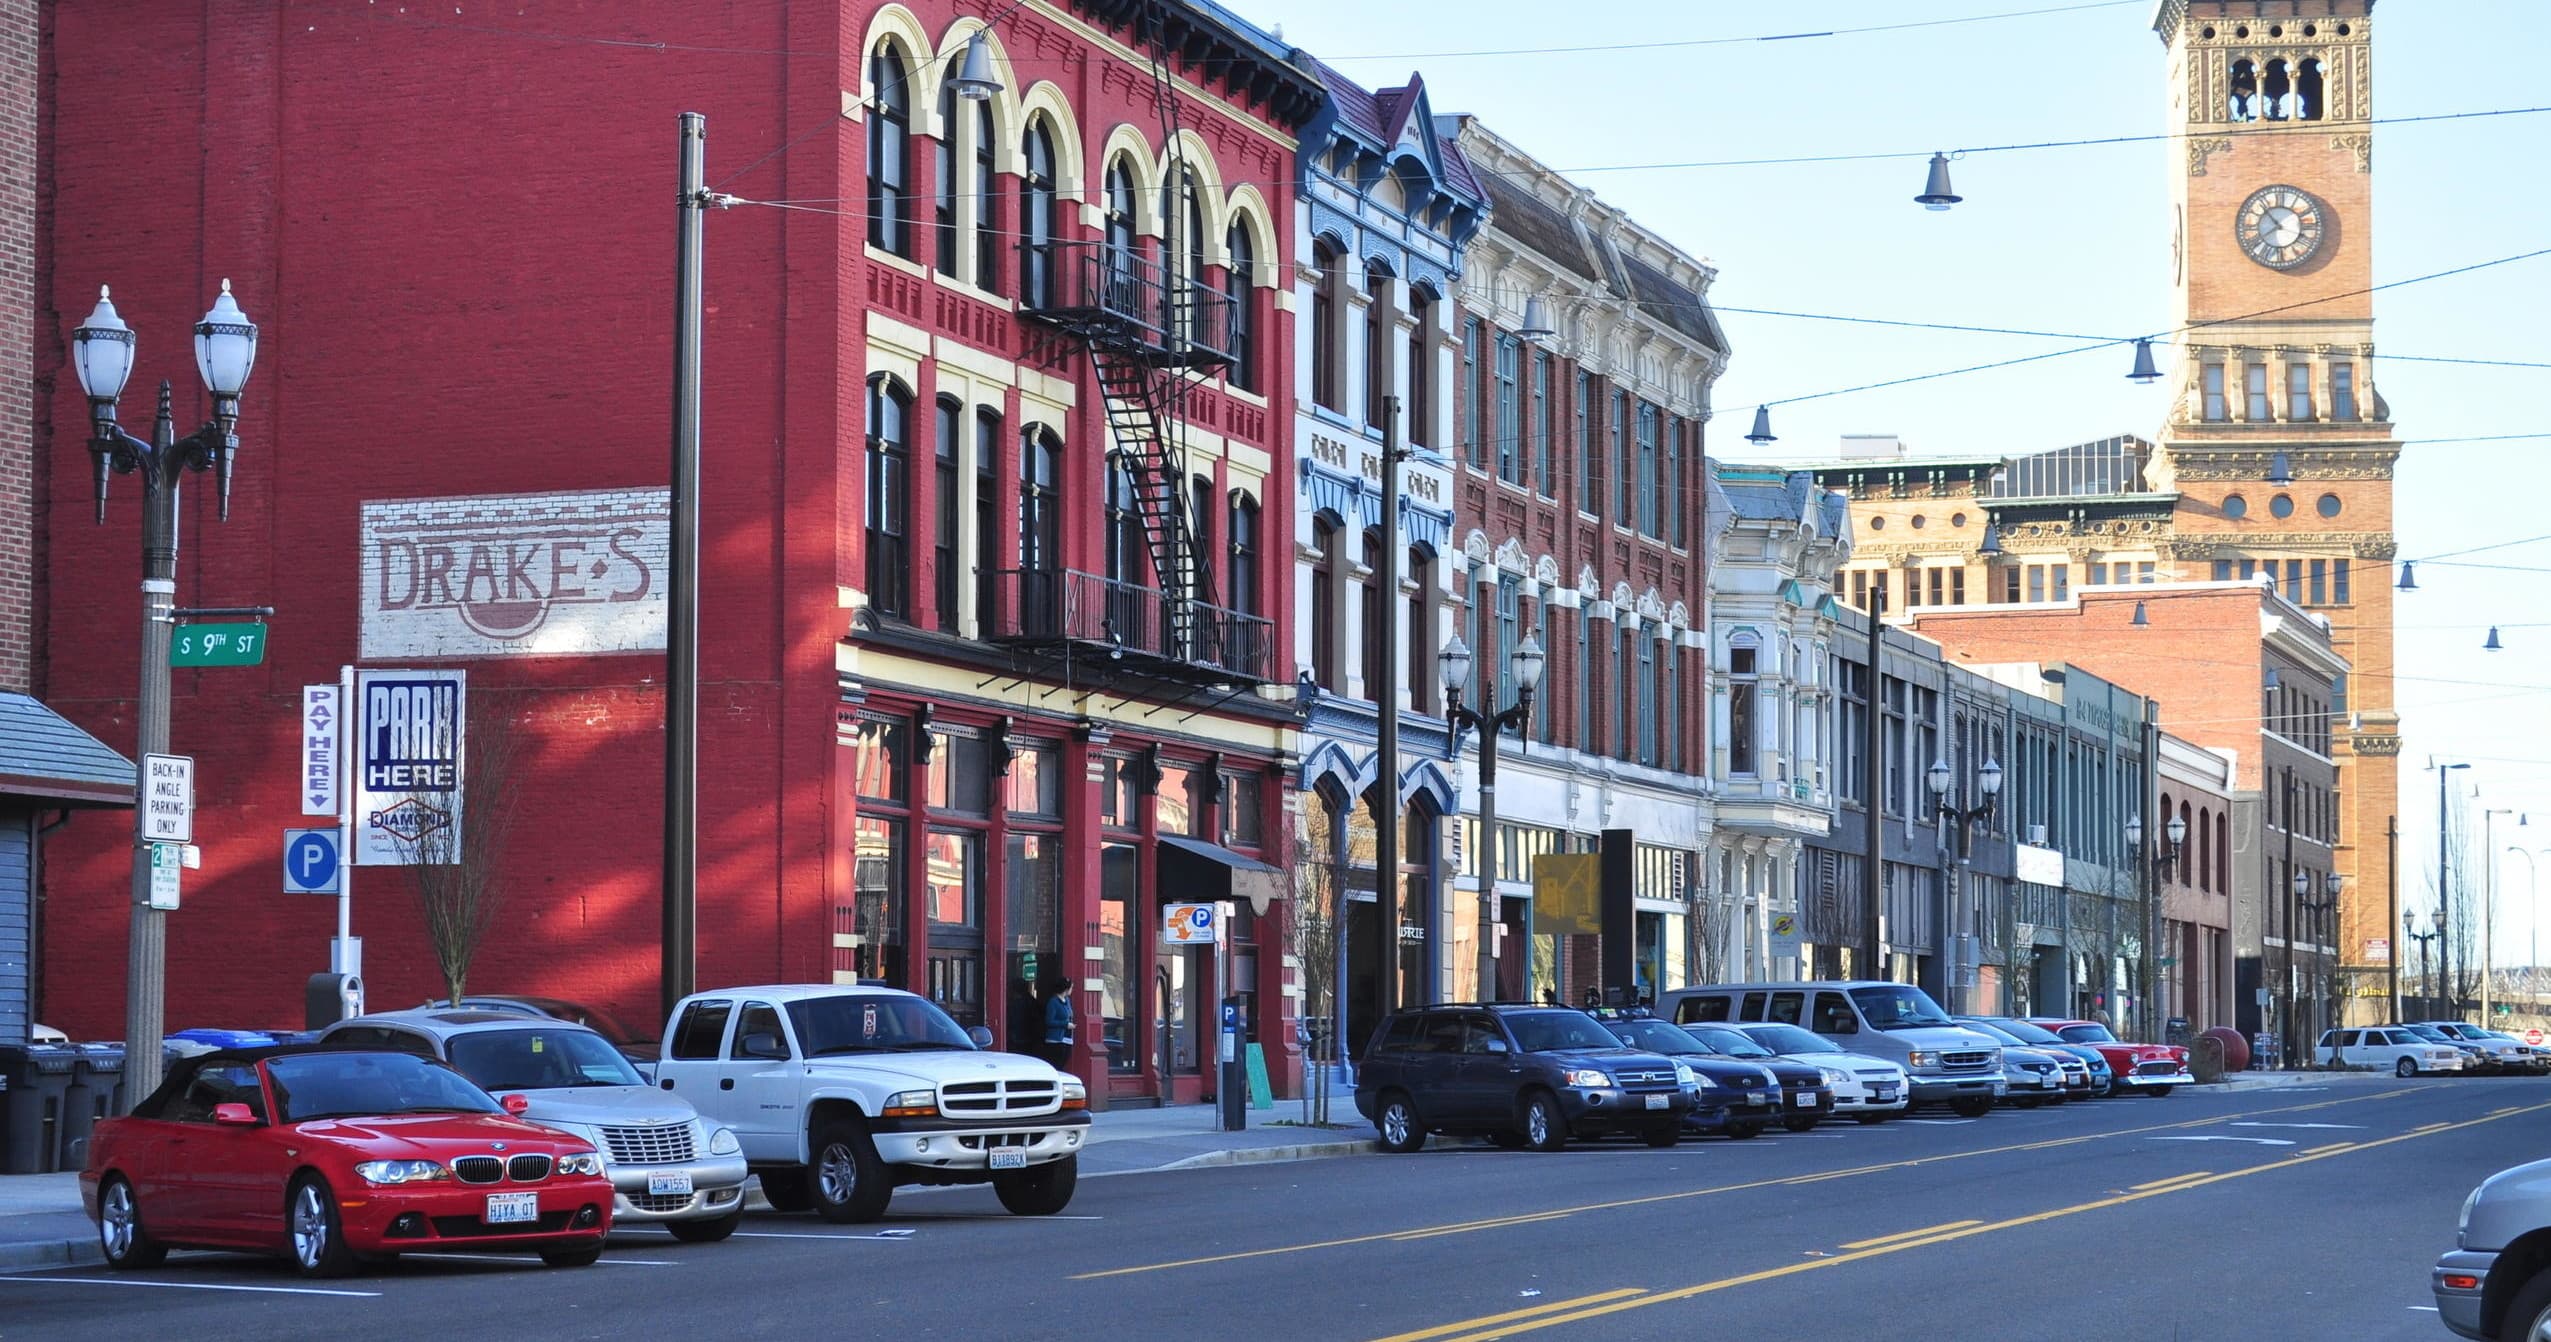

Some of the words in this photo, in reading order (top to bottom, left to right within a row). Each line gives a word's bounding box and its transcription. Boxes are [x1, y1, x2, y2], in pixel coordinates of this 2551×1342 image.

[180, 637, 191, 655] S
[203, 633, 227, 656] 9TH
[236, 635, 255, 654] ST
[309, 691, 331, 731] PAY
[369, 686, 453, 760] PARK
[152, 762, 185, 779] BACK-IN
[308, 736, 331, 790] HERE
[369, 765, 453, 786] HERE
[155, 782, 181, 797] ANGLE
[151, 800, 184, 816] PARKING
[156, 819, 176, 834] ONLY
[153, 848, 161, 864] 2
[303, 845, 324, 878] P
[1196, 911, 1208, 926] P
[1225, 1006, 1234, 1020] P
[490, 1203, 516, 1218] HIYA
